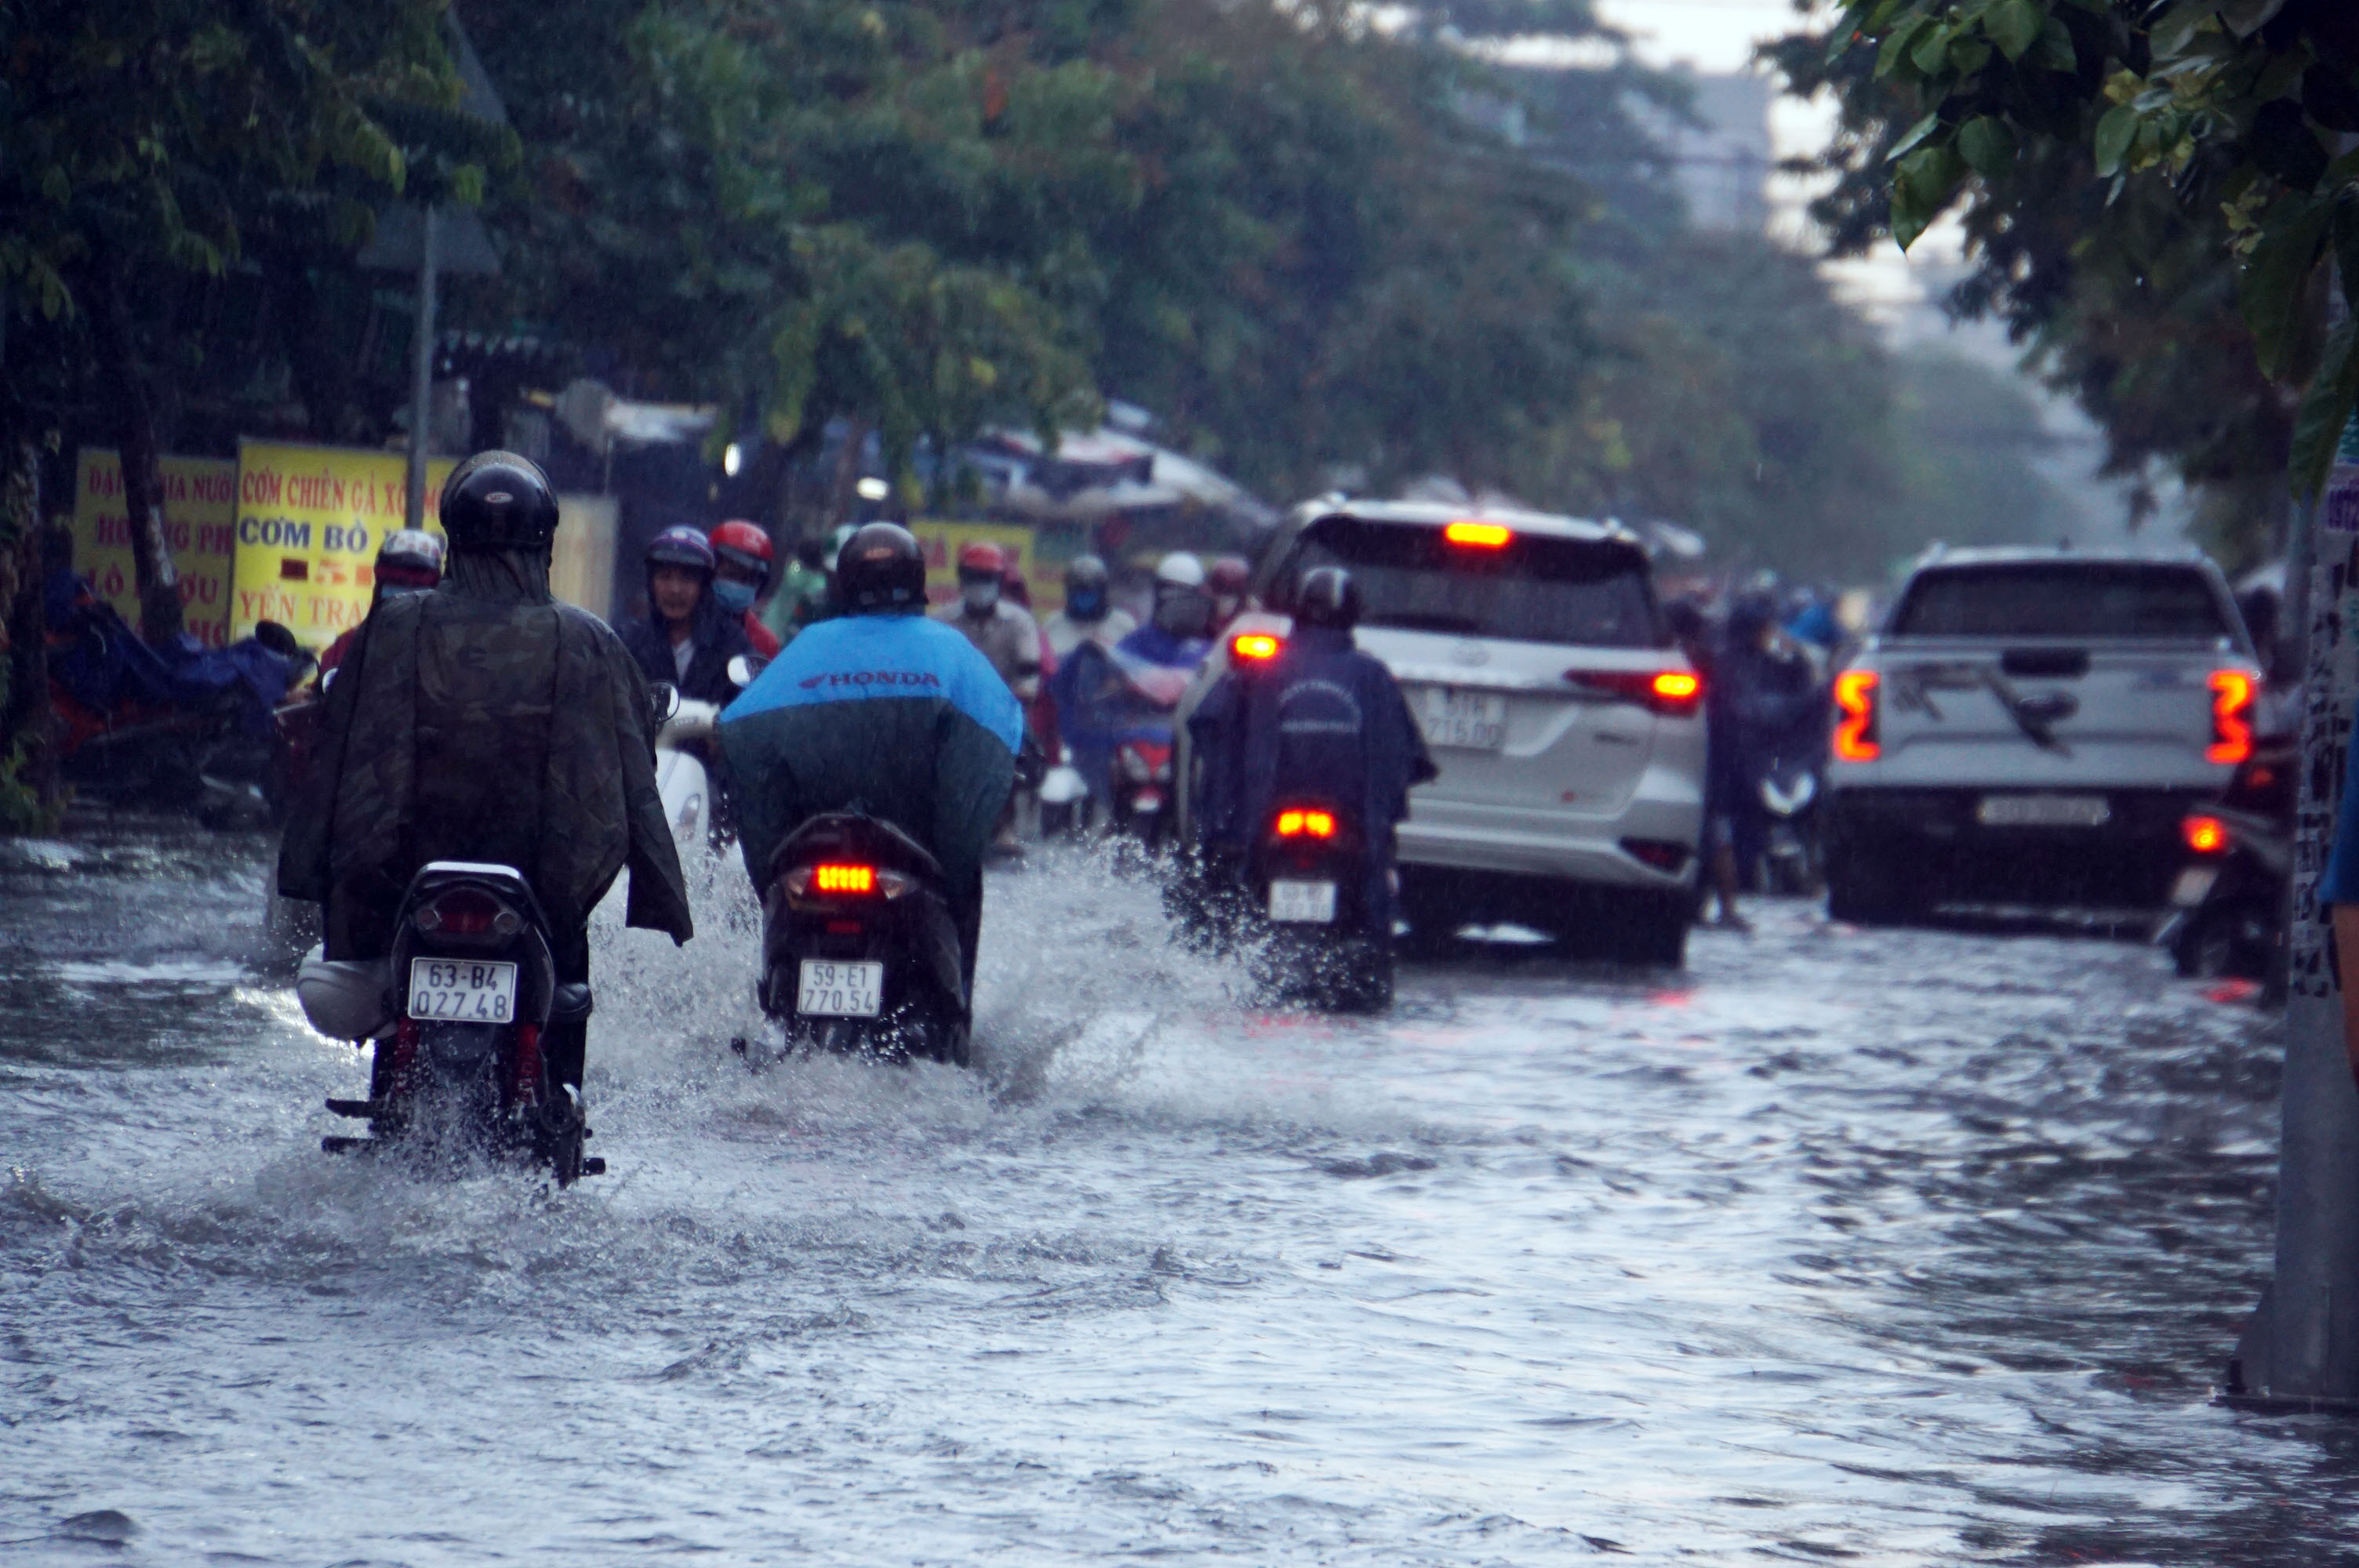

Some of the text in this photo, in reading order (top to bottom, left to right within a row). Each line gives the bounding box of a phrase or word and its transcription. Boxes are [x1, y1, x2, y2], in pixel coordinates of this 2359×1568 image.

[242, 464, 282, 506] CƠM
[287, 466, 346, 511] CHIÊN
[351, 470, 377, 514] GÀ
[239, 515, 311, 550] CƠM
[324, 518, 368, 553] BÒ
[309, 593, 373, 628] TRA
[829, 671, 941, 688] HONDA
[429, 964, 498, 991] 63-B4
[813, 964, 867, 988] 59-E1
[416, 989, 507, 1018] 027.48
[805, 989, 874, 1012] 770.54
